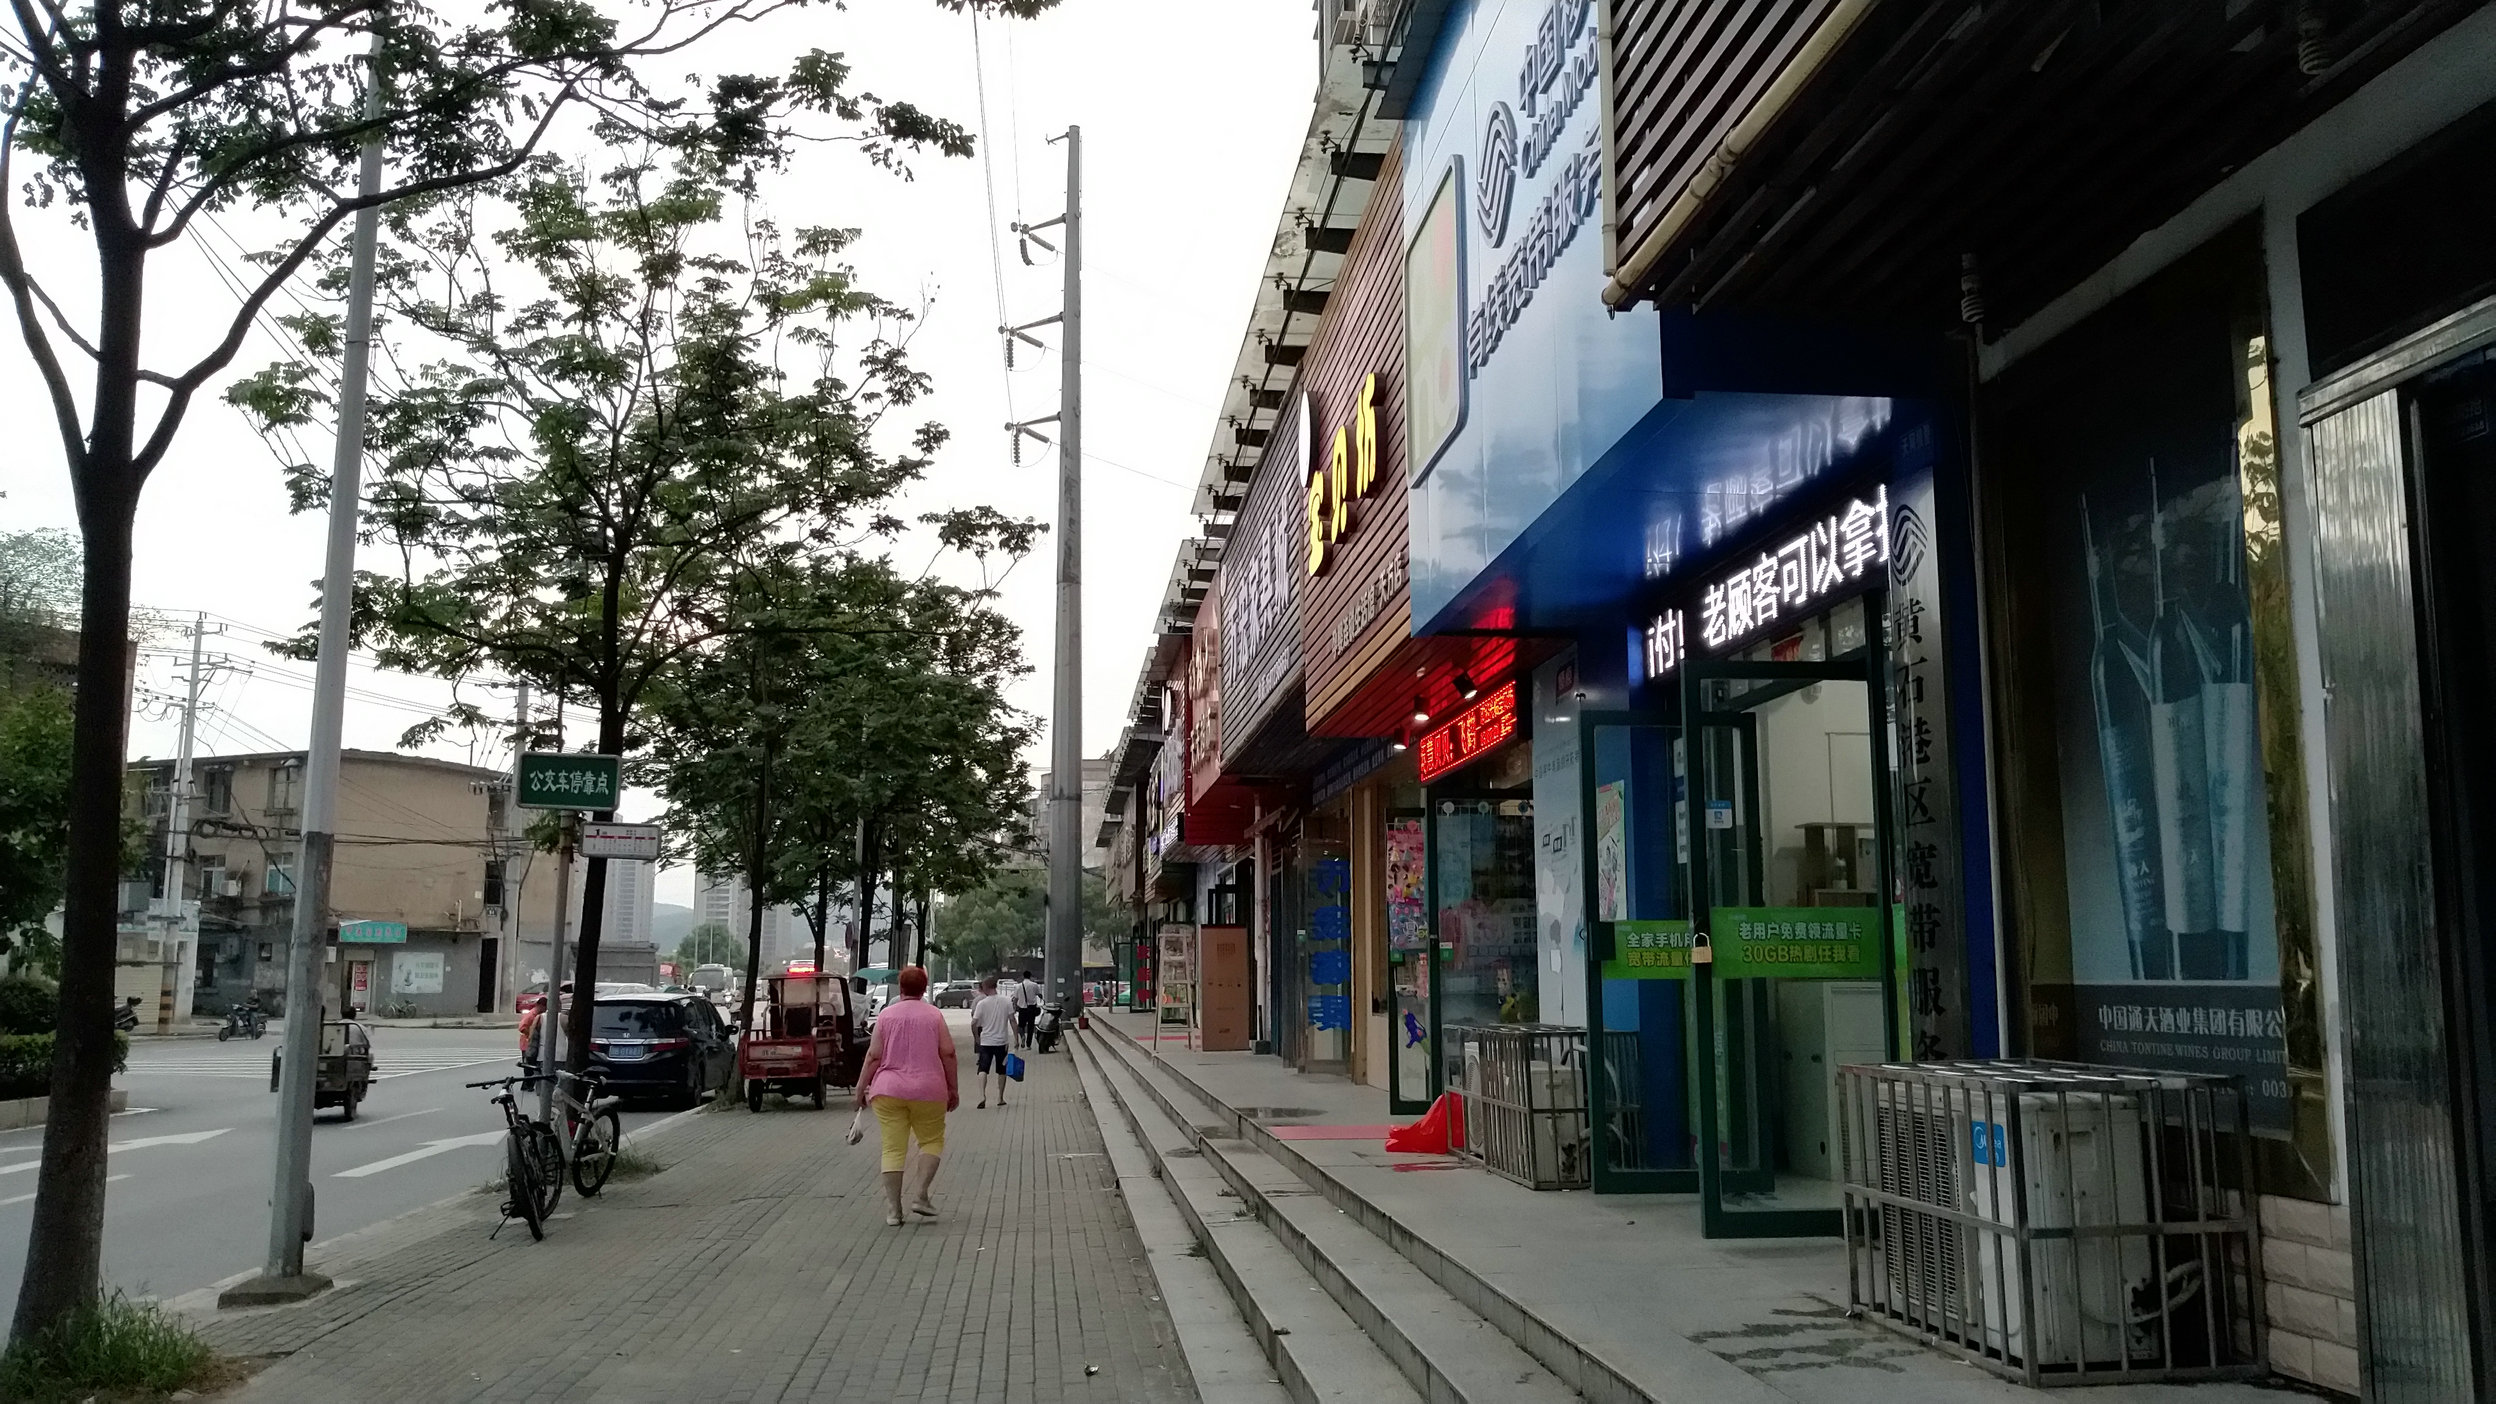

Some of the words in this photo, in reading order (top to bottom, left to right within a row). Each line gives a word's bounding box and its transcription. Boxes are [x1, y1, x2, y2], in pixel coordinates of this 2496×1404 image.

[1521, 100, 1564, 179] China
[530, 768, 609, 796] 公交车停靠点
[1739, 921, 1862, 941] 老用户免费领流量卡
[1743, 944, 1861, 963] 30GB热剧任我看
[2099, 1040, 2128, 1056] CHINA
[2131, 1041, 2174, 1057] TONTINE
[2175, 1043, 2209, 1060] WINES
[2212, 1046, 2251, 1062] GROUP
